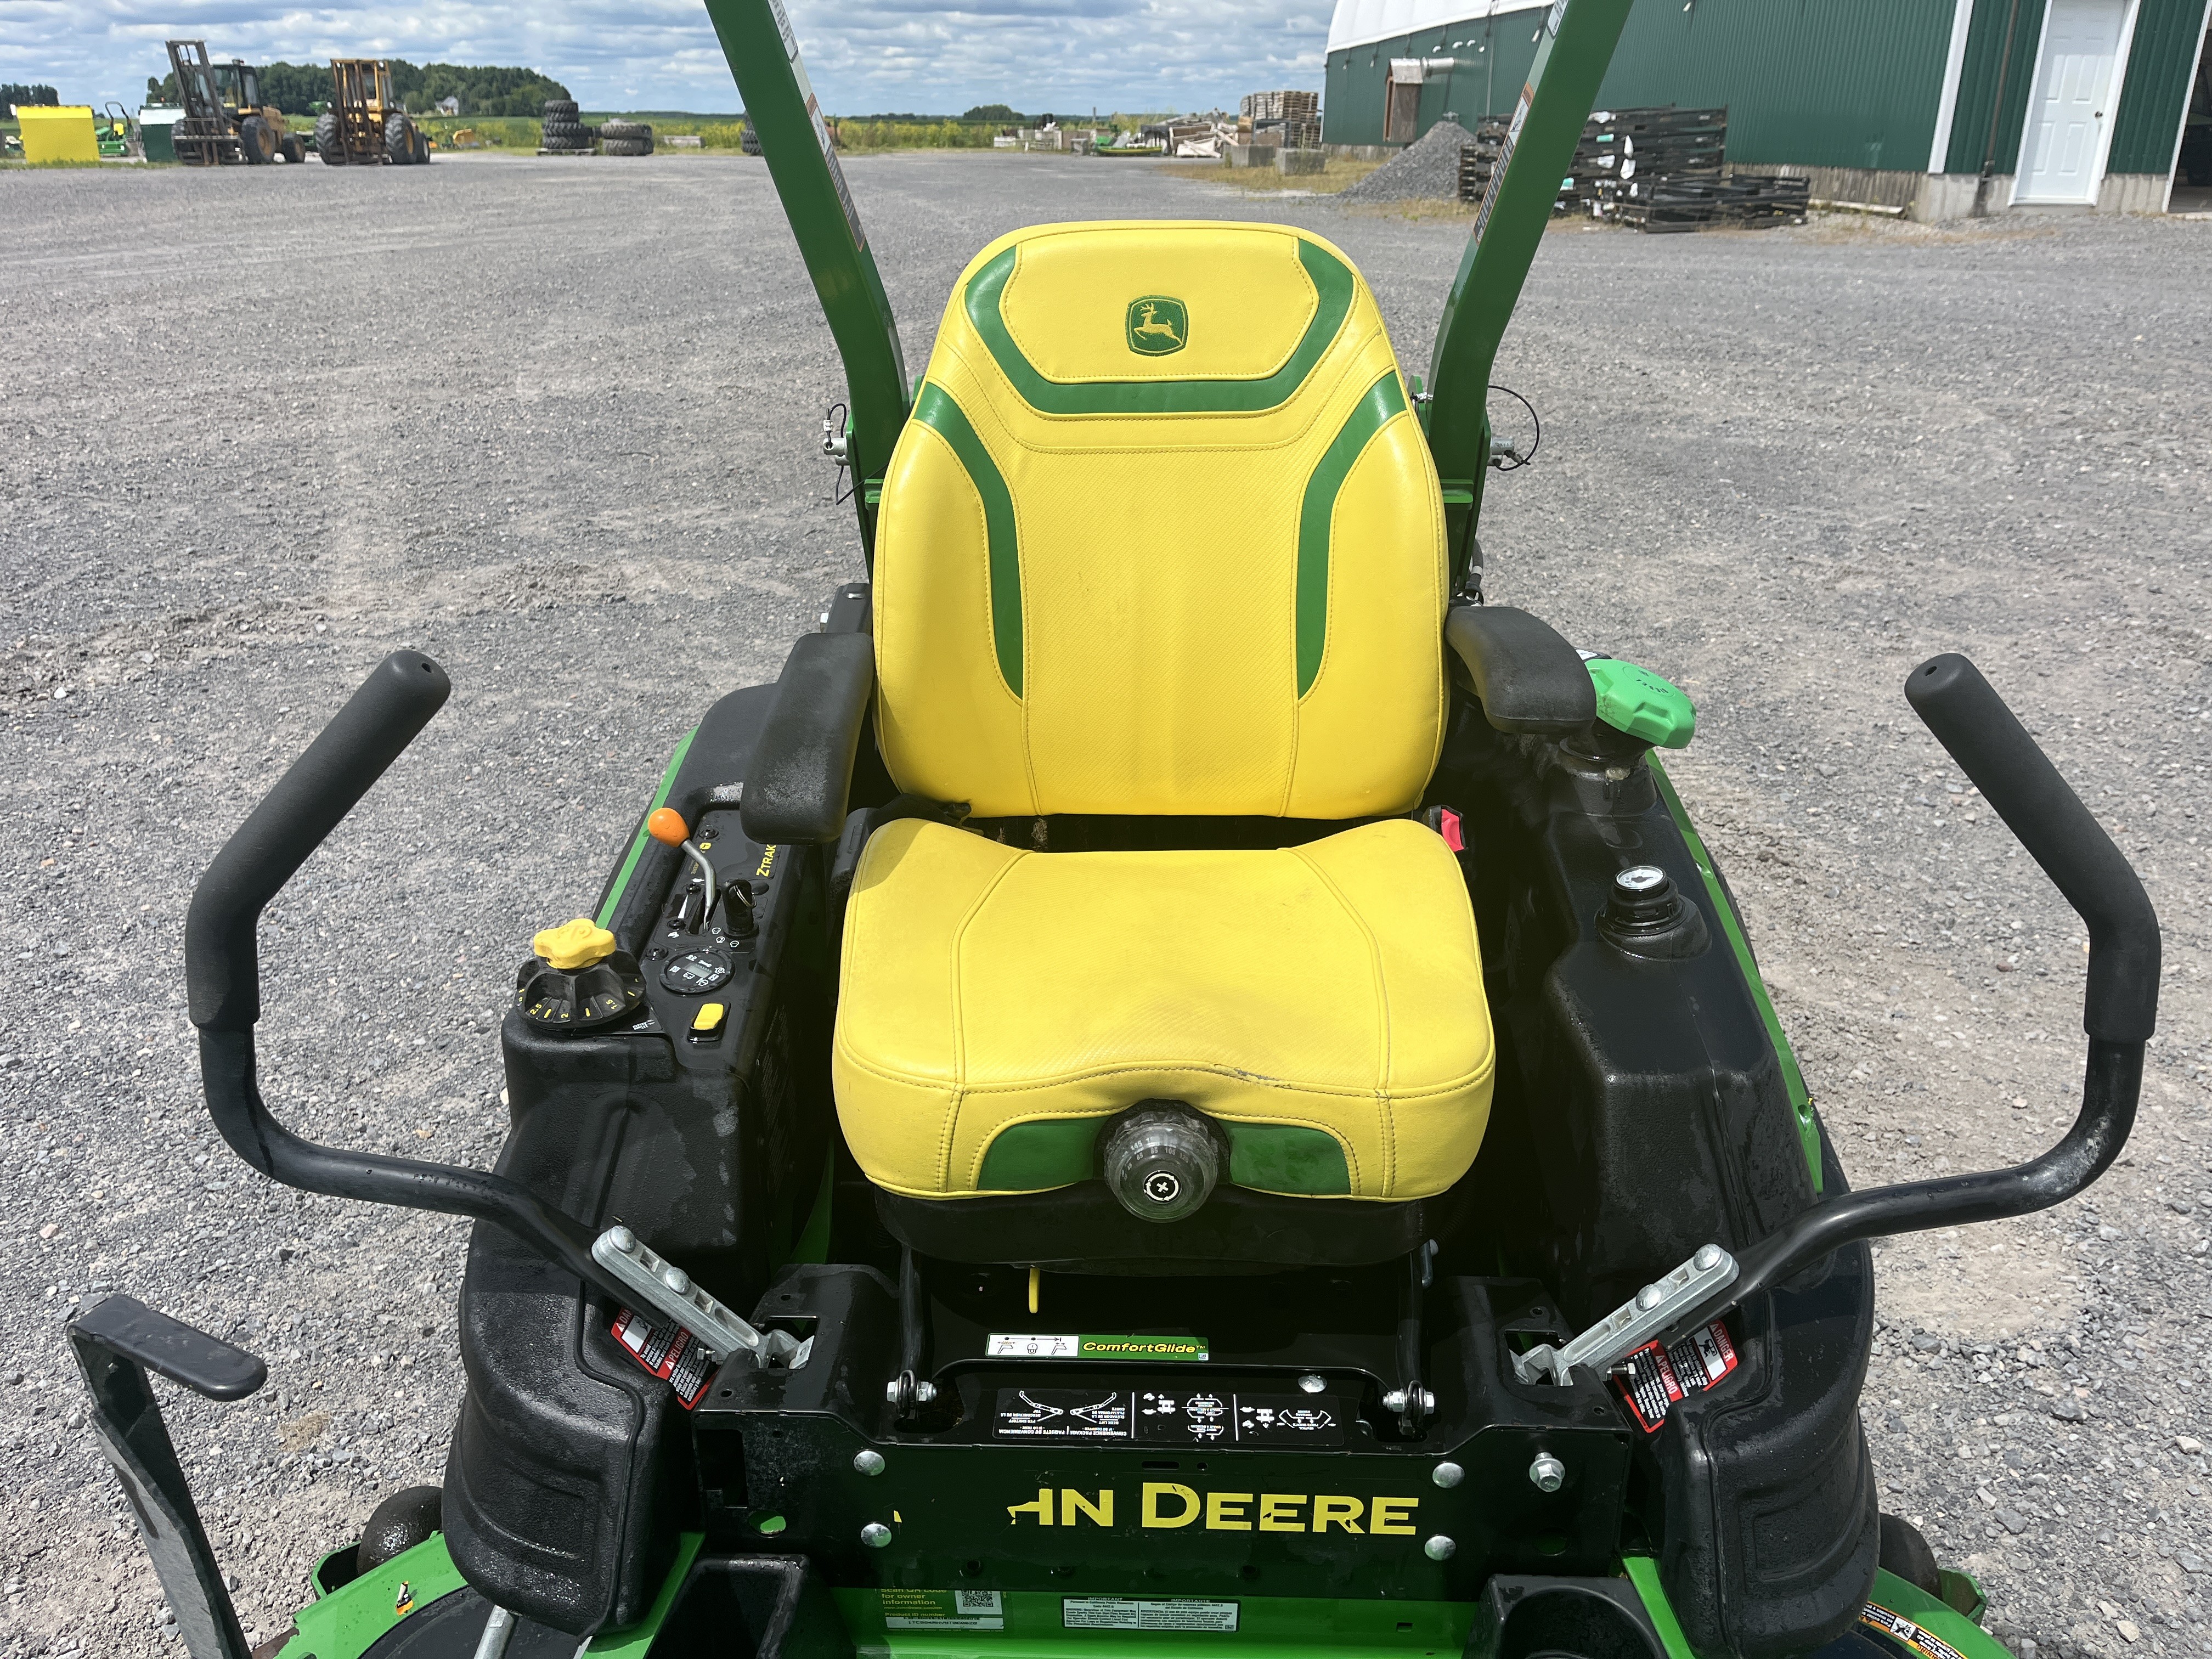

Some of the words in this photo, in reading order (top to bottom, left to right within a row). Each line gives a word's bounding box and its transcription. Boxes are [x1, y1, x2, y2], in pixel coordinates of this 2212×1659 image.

[755, 844, 777, 877] ZTRAK
[529, 1003, 543, 1015] 2.5
[605, 998, 617, 1010] 1.5
[1165, 1147, 1176, 1155] 105
[670, 1331, 690, 1362] PELIGRO
[1714, 1328, 1734, 1363] DANGER
[1659, 1362, 1679, 1395] PELIGRO
[1142, 1482, 1419, 1536] DEERE
